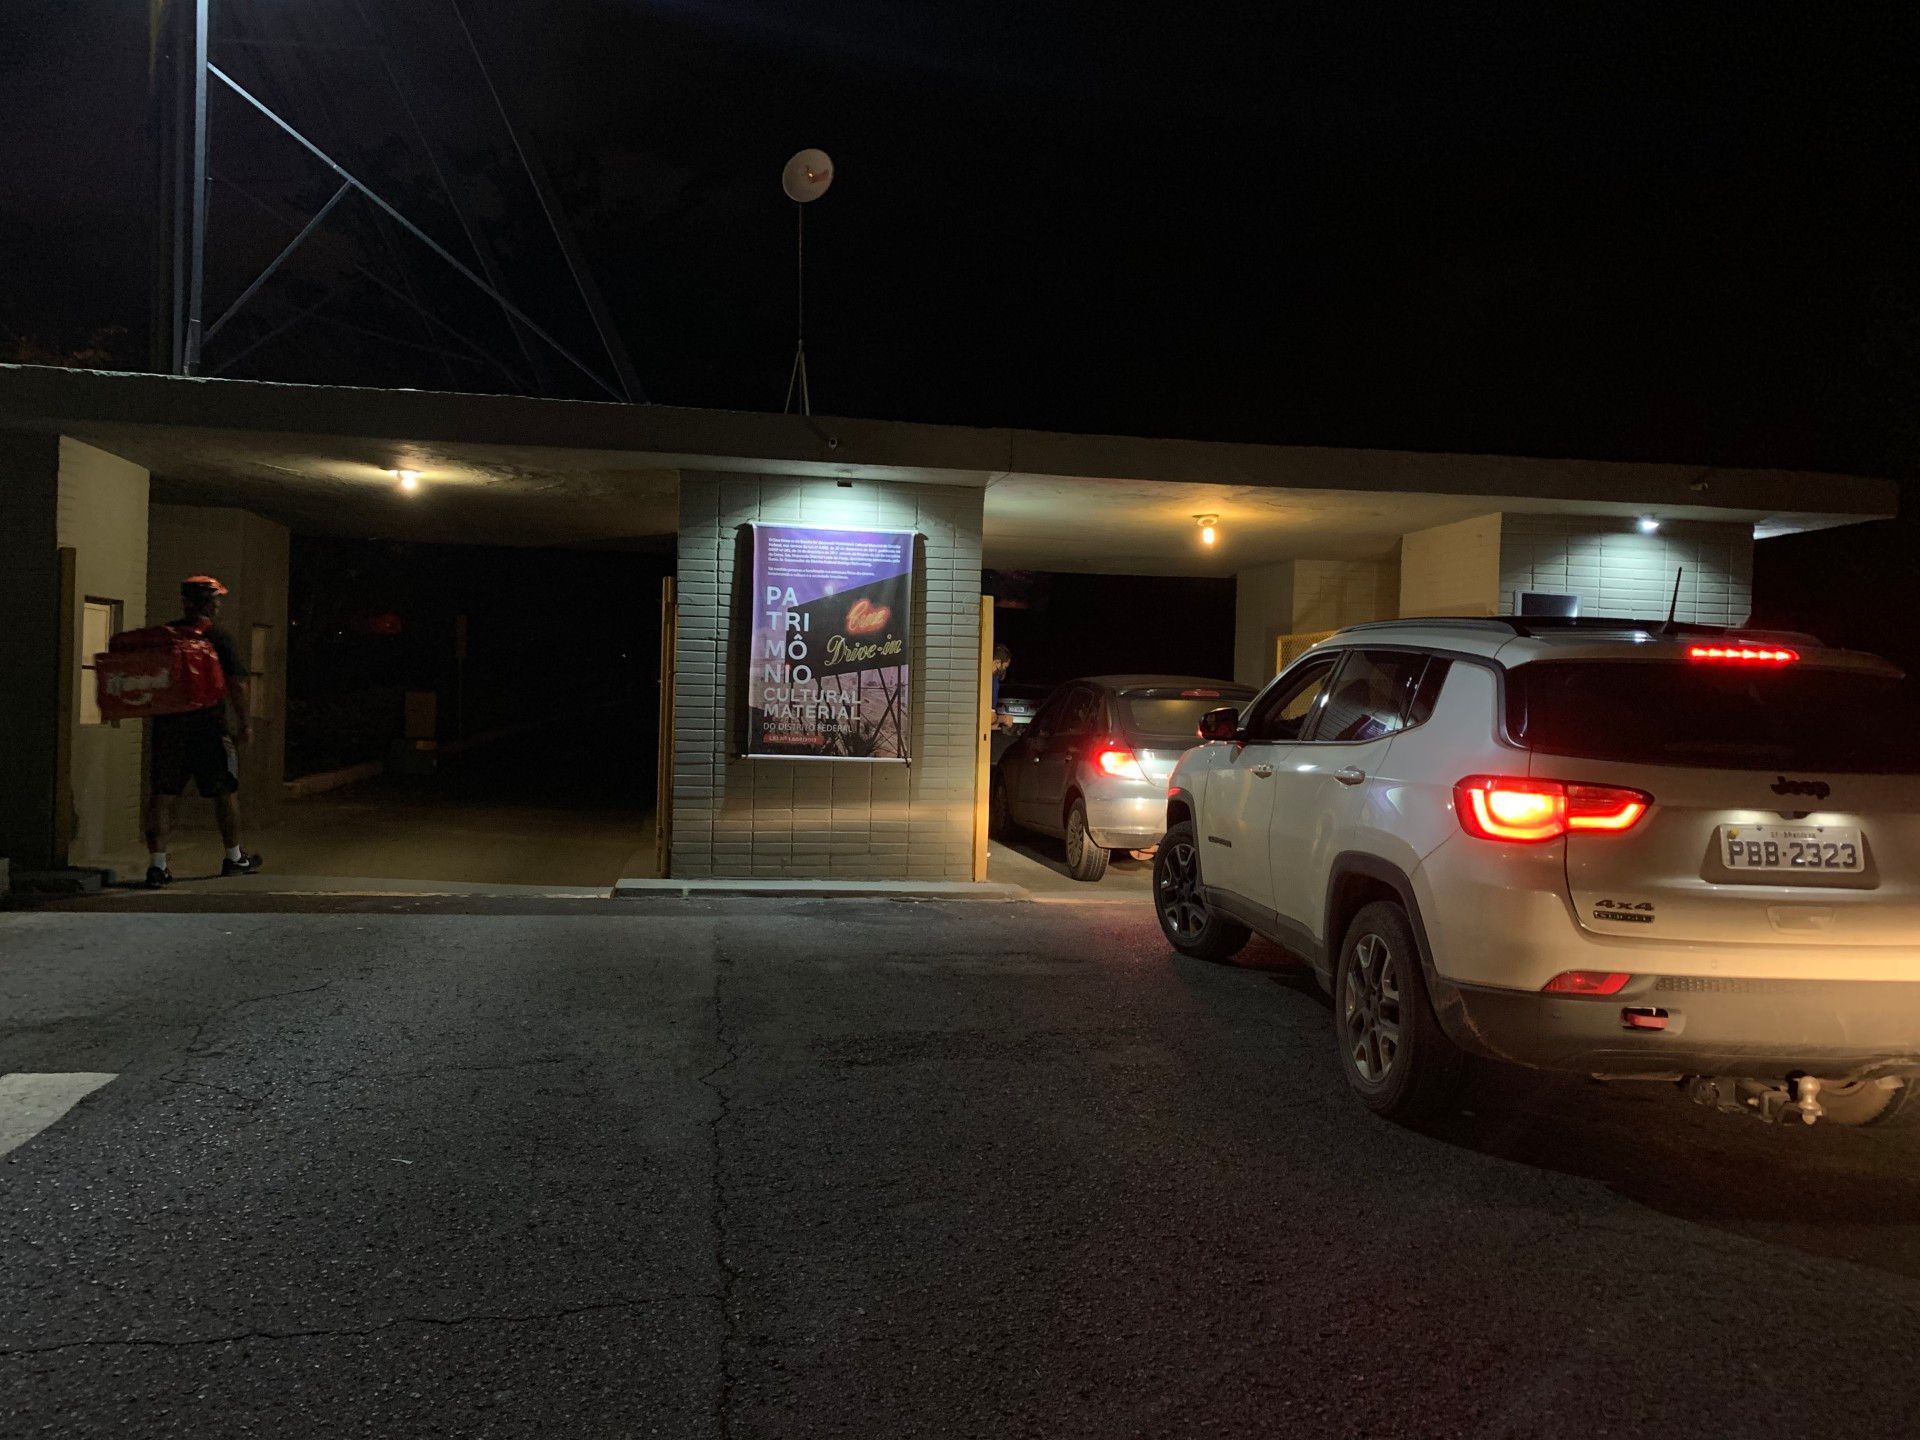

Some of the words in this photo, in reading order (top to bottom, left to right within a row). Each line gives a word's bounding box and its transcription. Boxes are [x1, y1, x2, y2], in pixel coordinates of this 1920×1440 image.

[767, 586, 798, 606] PA
[766, 611, 809, 632] TRI
[765, 634, 807, 660] MÔ
[824, 634, 902, 666] Drive-in
[764, 664, 812, 684] NIO
[763, 687, 861, 704] CULTURAL
[763, 704, 861, 720] MATERIAL
[763, 722, 776, 730] DO
